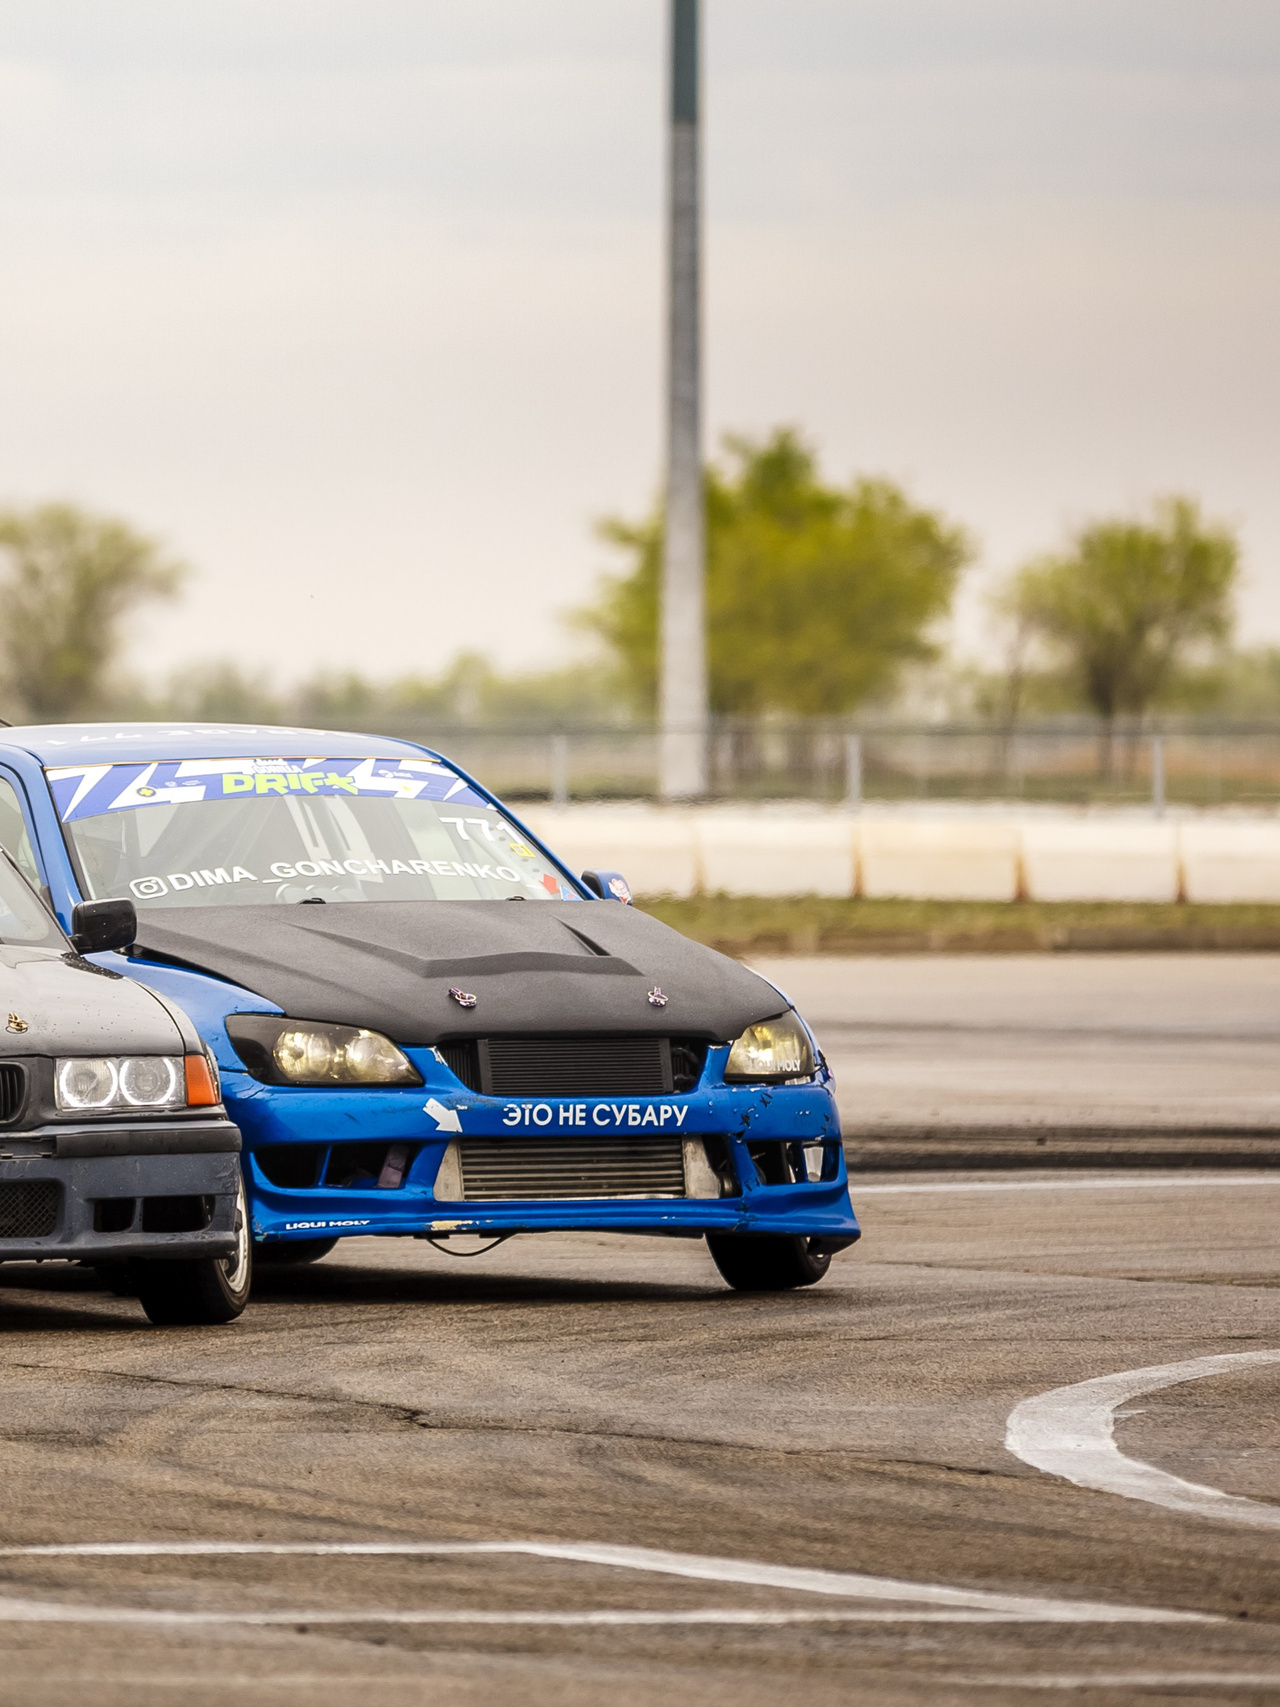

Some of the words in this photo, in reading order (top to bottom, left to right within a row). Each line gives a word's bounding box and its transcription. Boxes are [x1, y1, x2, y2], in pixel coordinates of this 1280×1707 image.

[222, 772, 359, 796] DRIFT
[439, 816, 525, 846] 771
[777, 1060, 801, 1072] MOLY
[502, 1104, 553, 1126] ЭТО
[559, 1104, 587, 1126] НЕ
[592, 1104, 689, 1126] СУБАРУ
[285, 1221, 326, 1230] LIQUI
[329, 1220, 371, 1228] MOLY
